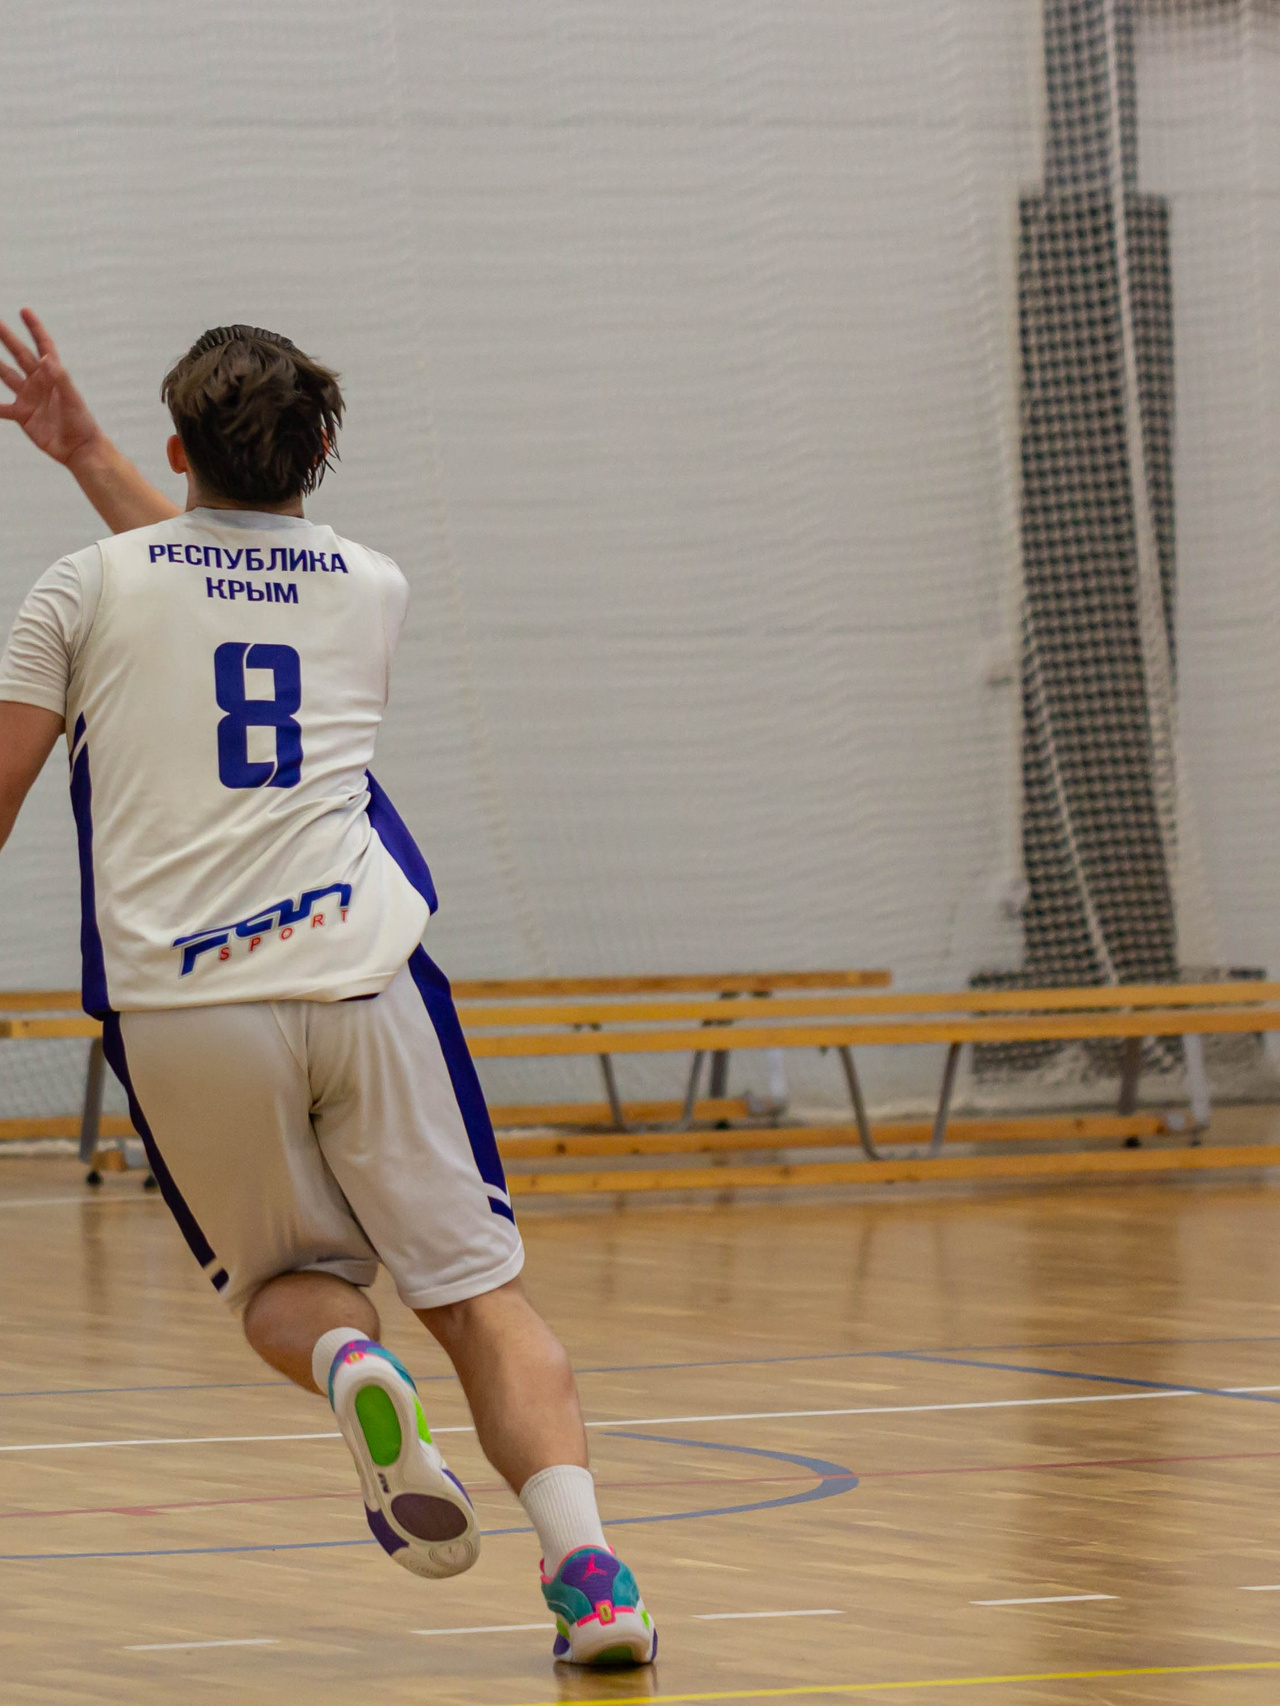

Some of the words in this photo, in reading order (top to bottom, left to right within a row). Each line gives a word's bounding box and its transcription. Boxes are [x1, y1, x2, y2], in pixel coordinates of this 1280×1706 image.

[149, 543, 349, 573] РЕСПУБЛИКА
[205, 576, 299, 604] КРЫМ
[214, 641, 304, 789] 8
[219, 908, 349, 961] SPORT
